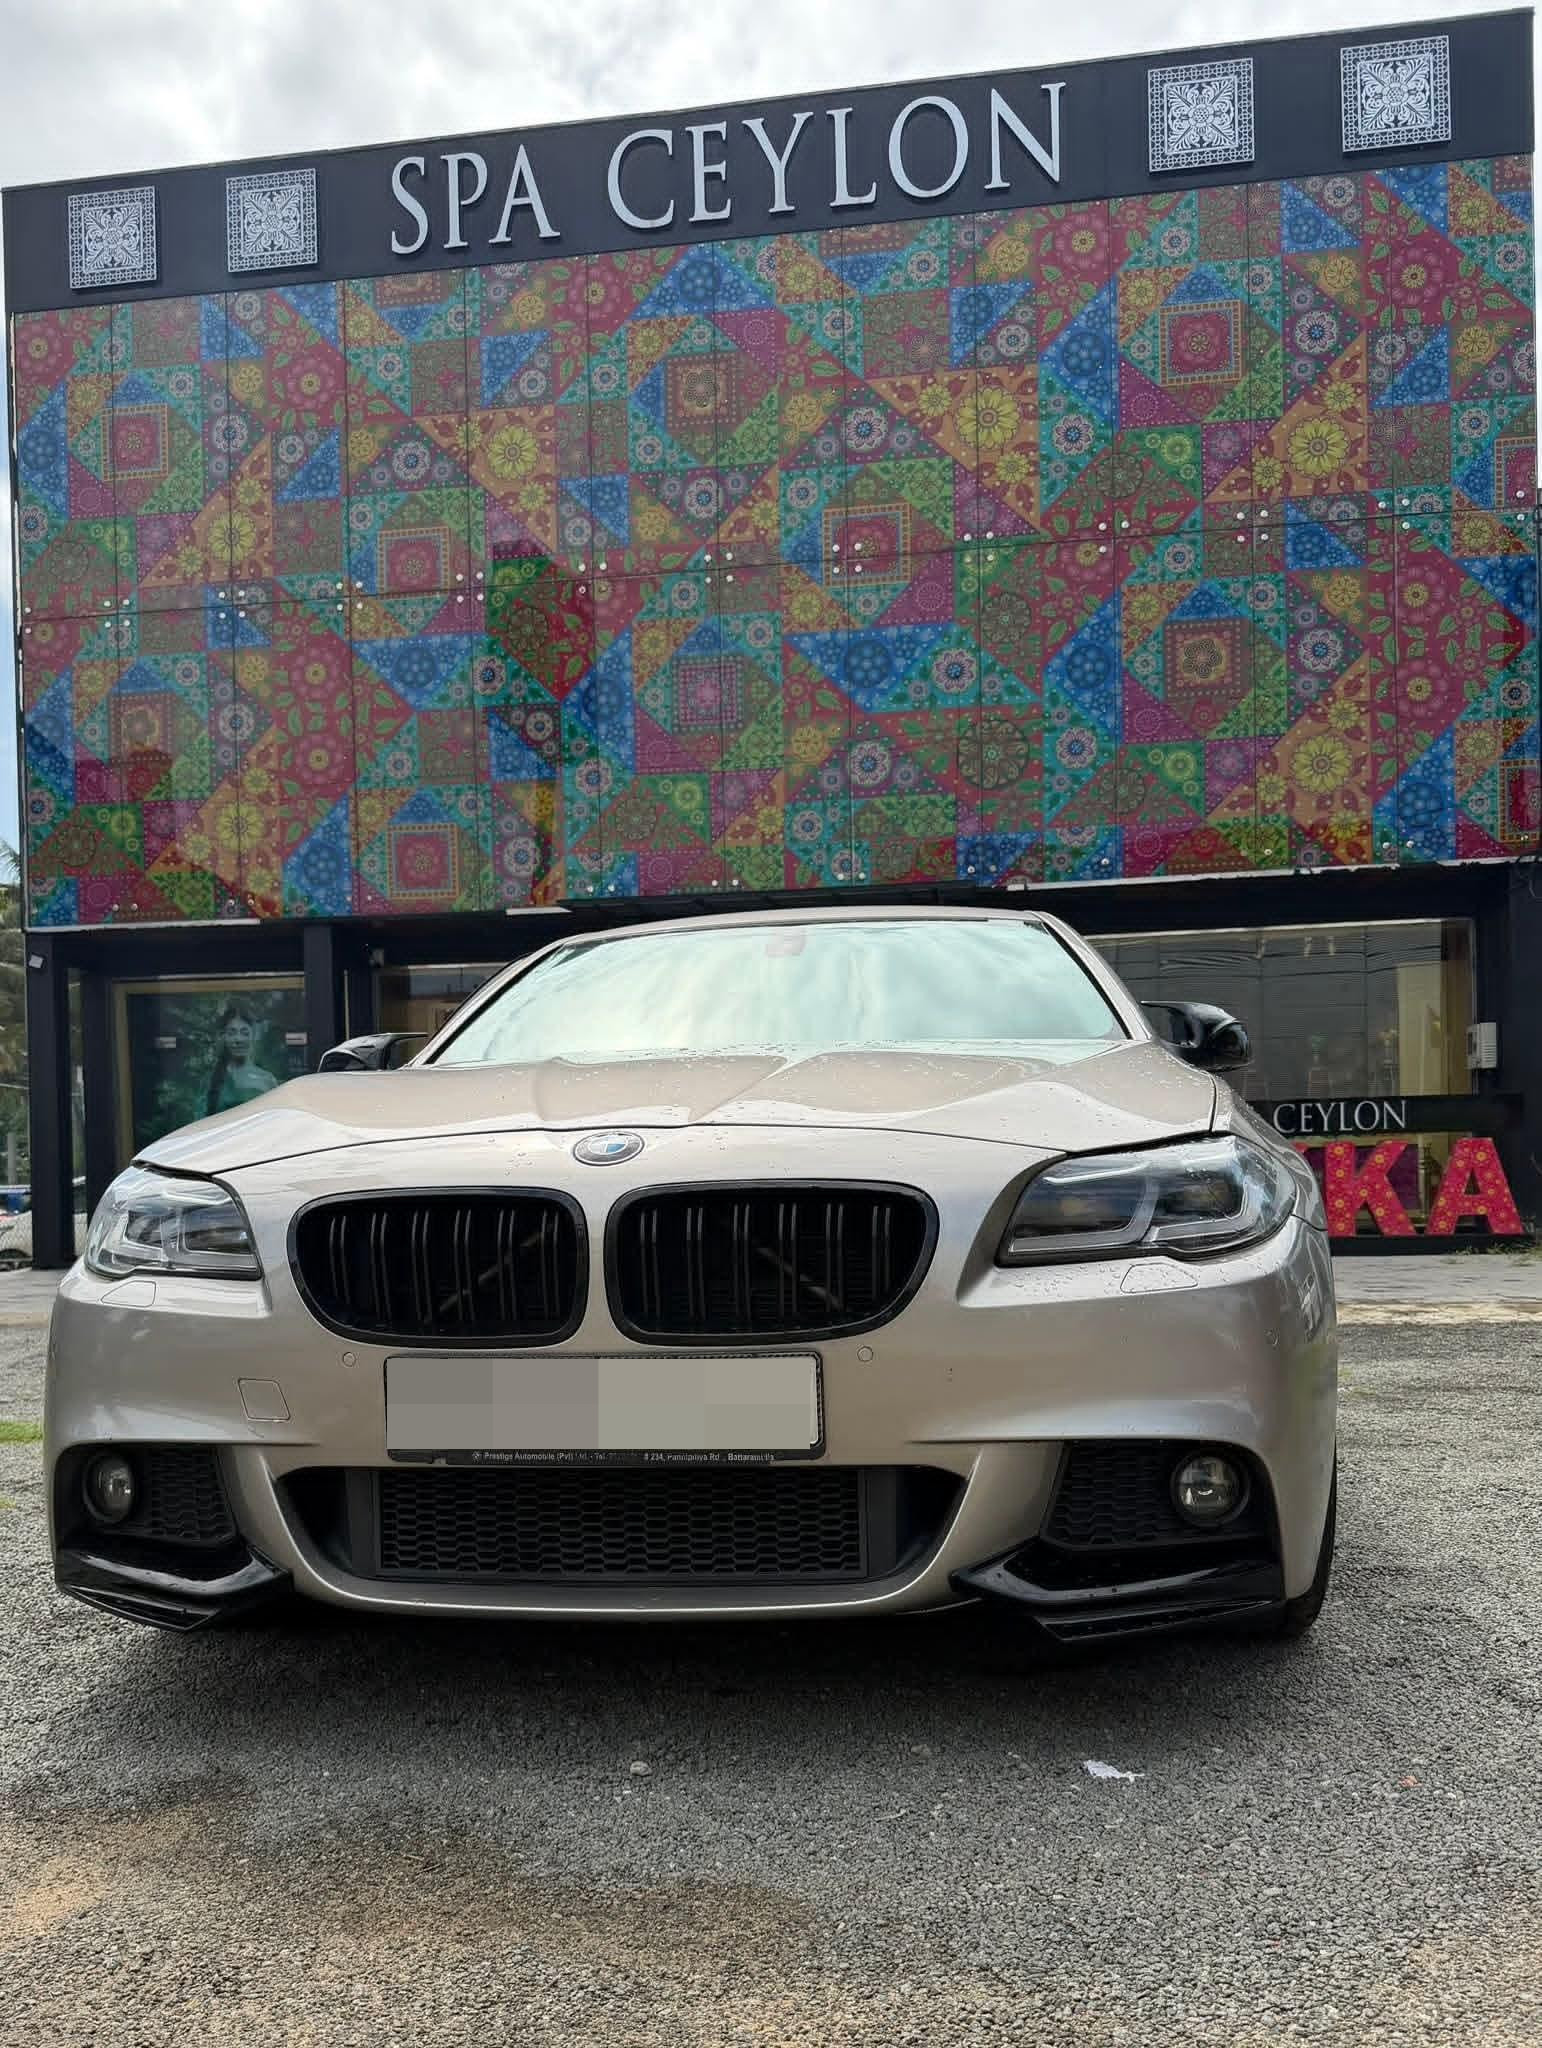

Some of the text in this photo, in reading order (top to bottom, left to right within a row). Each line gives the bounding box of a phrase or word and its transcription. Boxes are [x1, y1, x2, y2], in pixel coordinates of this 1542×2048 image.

[391, 81, 1067, 254] SPA CEYLON
[1273, 1100, 1407, 1133] CEYLON
[1292, 1138, 1525, 1237] KA
[515, 1451, 555, 1461] Automobile
